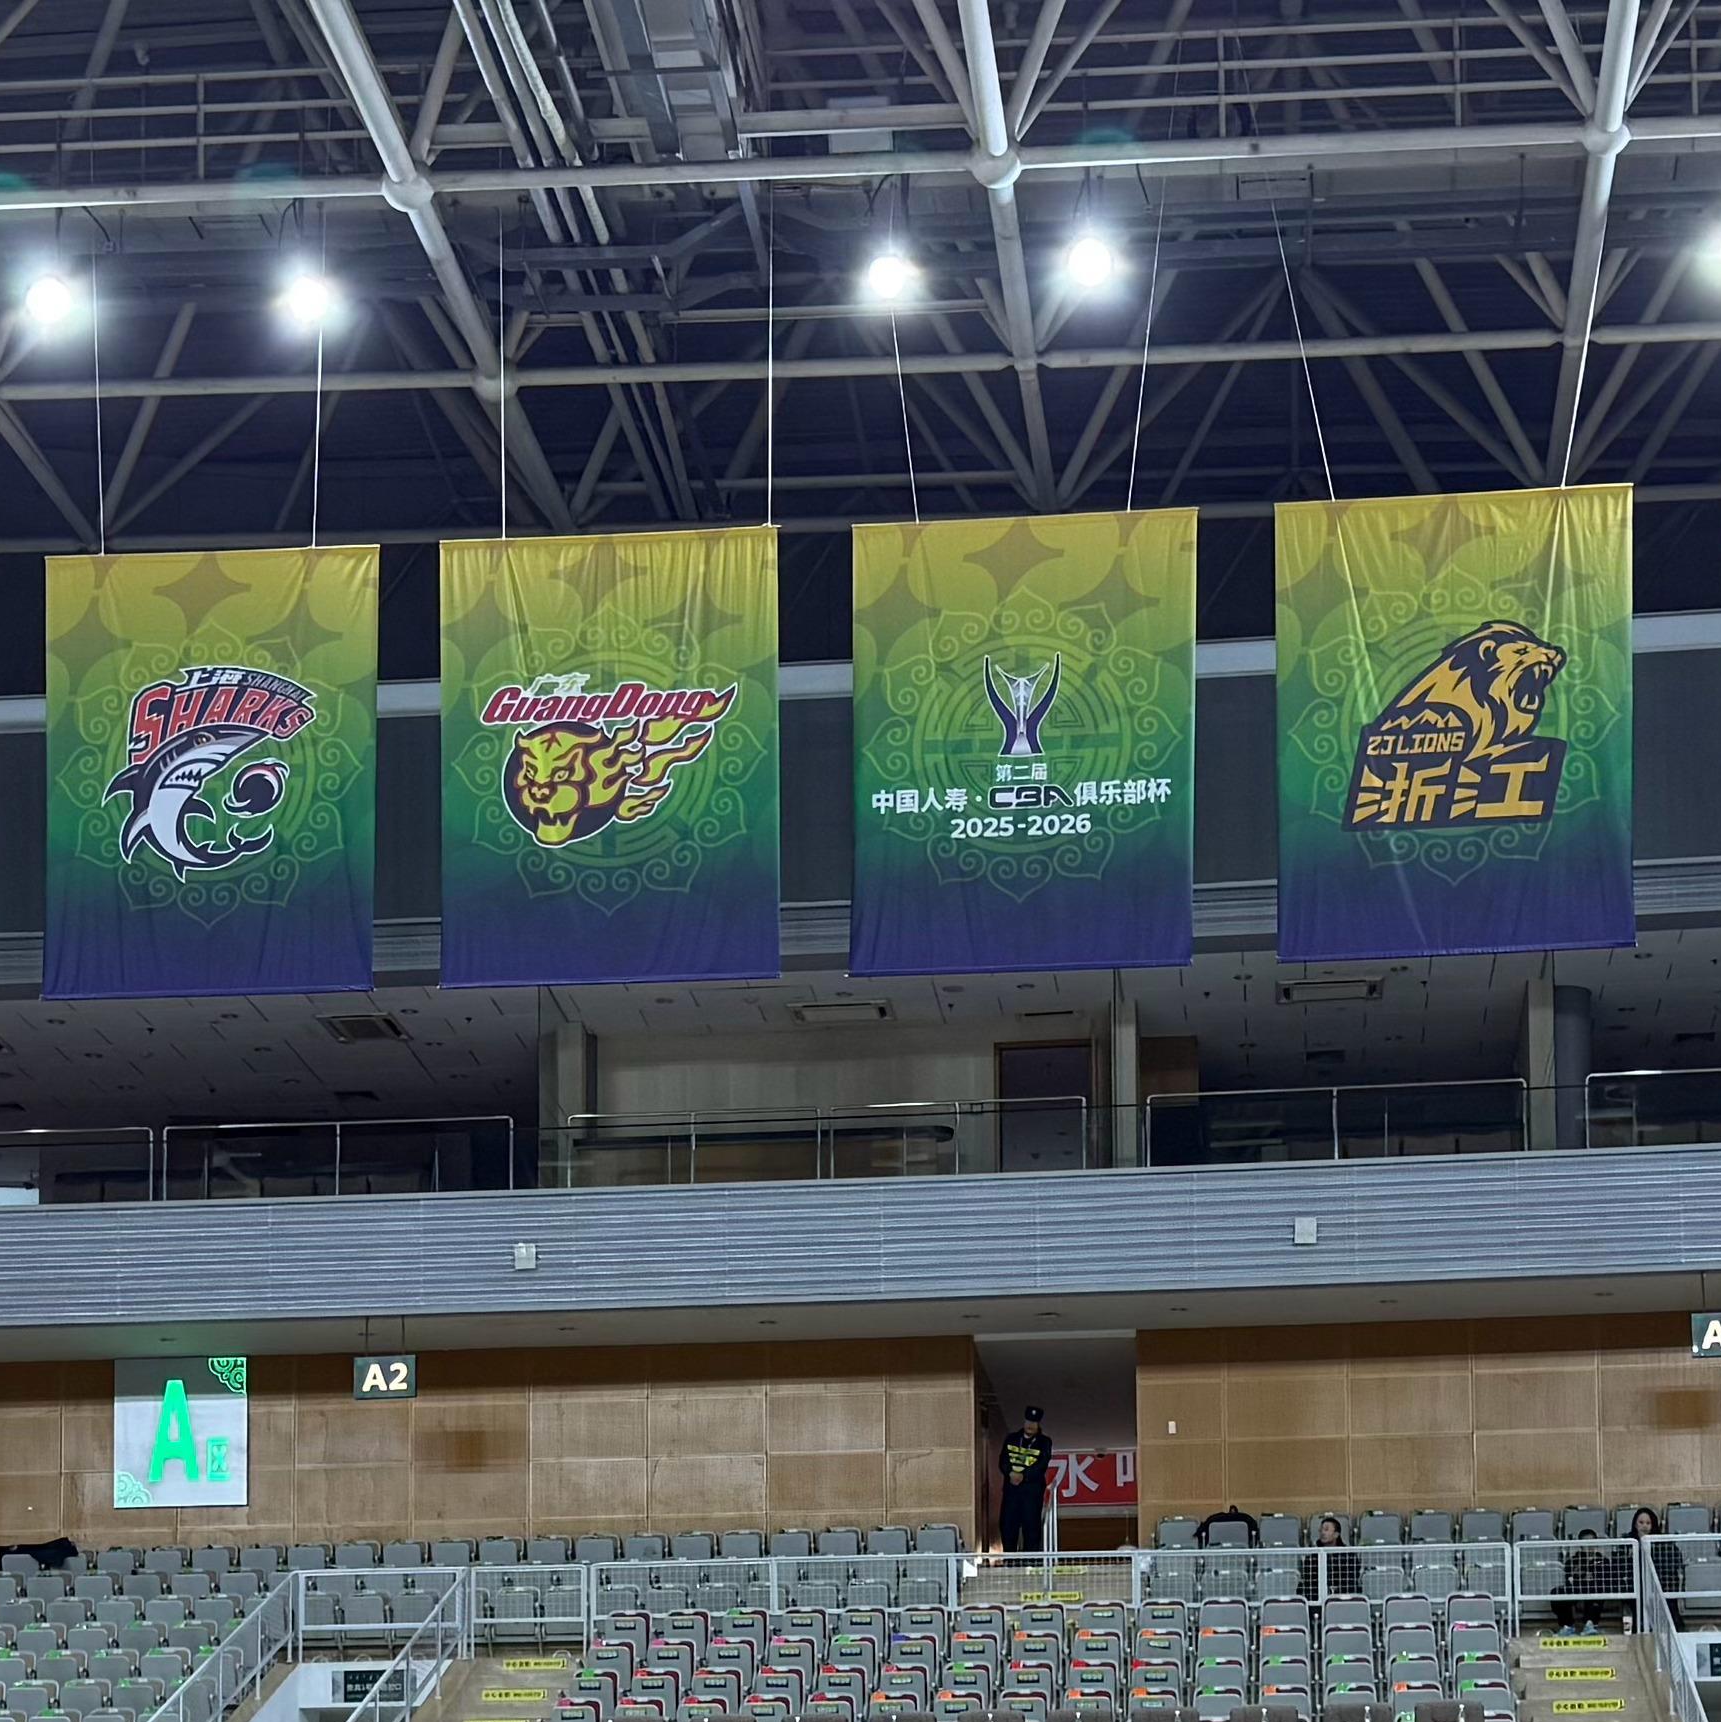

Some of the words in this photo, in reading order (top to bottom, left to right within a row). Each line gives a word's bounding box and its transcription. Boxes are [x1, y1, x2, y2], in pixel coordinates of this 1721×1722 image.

[132, 685, 312, 765] SHARKS
[1396, 731, 1466, 754] LIONS
[995, 762, 1047, 782] 第二届
[1352, 752, 1550, 824] 浙江
[950, 813, 1092, 839] 2025-2026
[361, 1363, 409, 1392] A2
